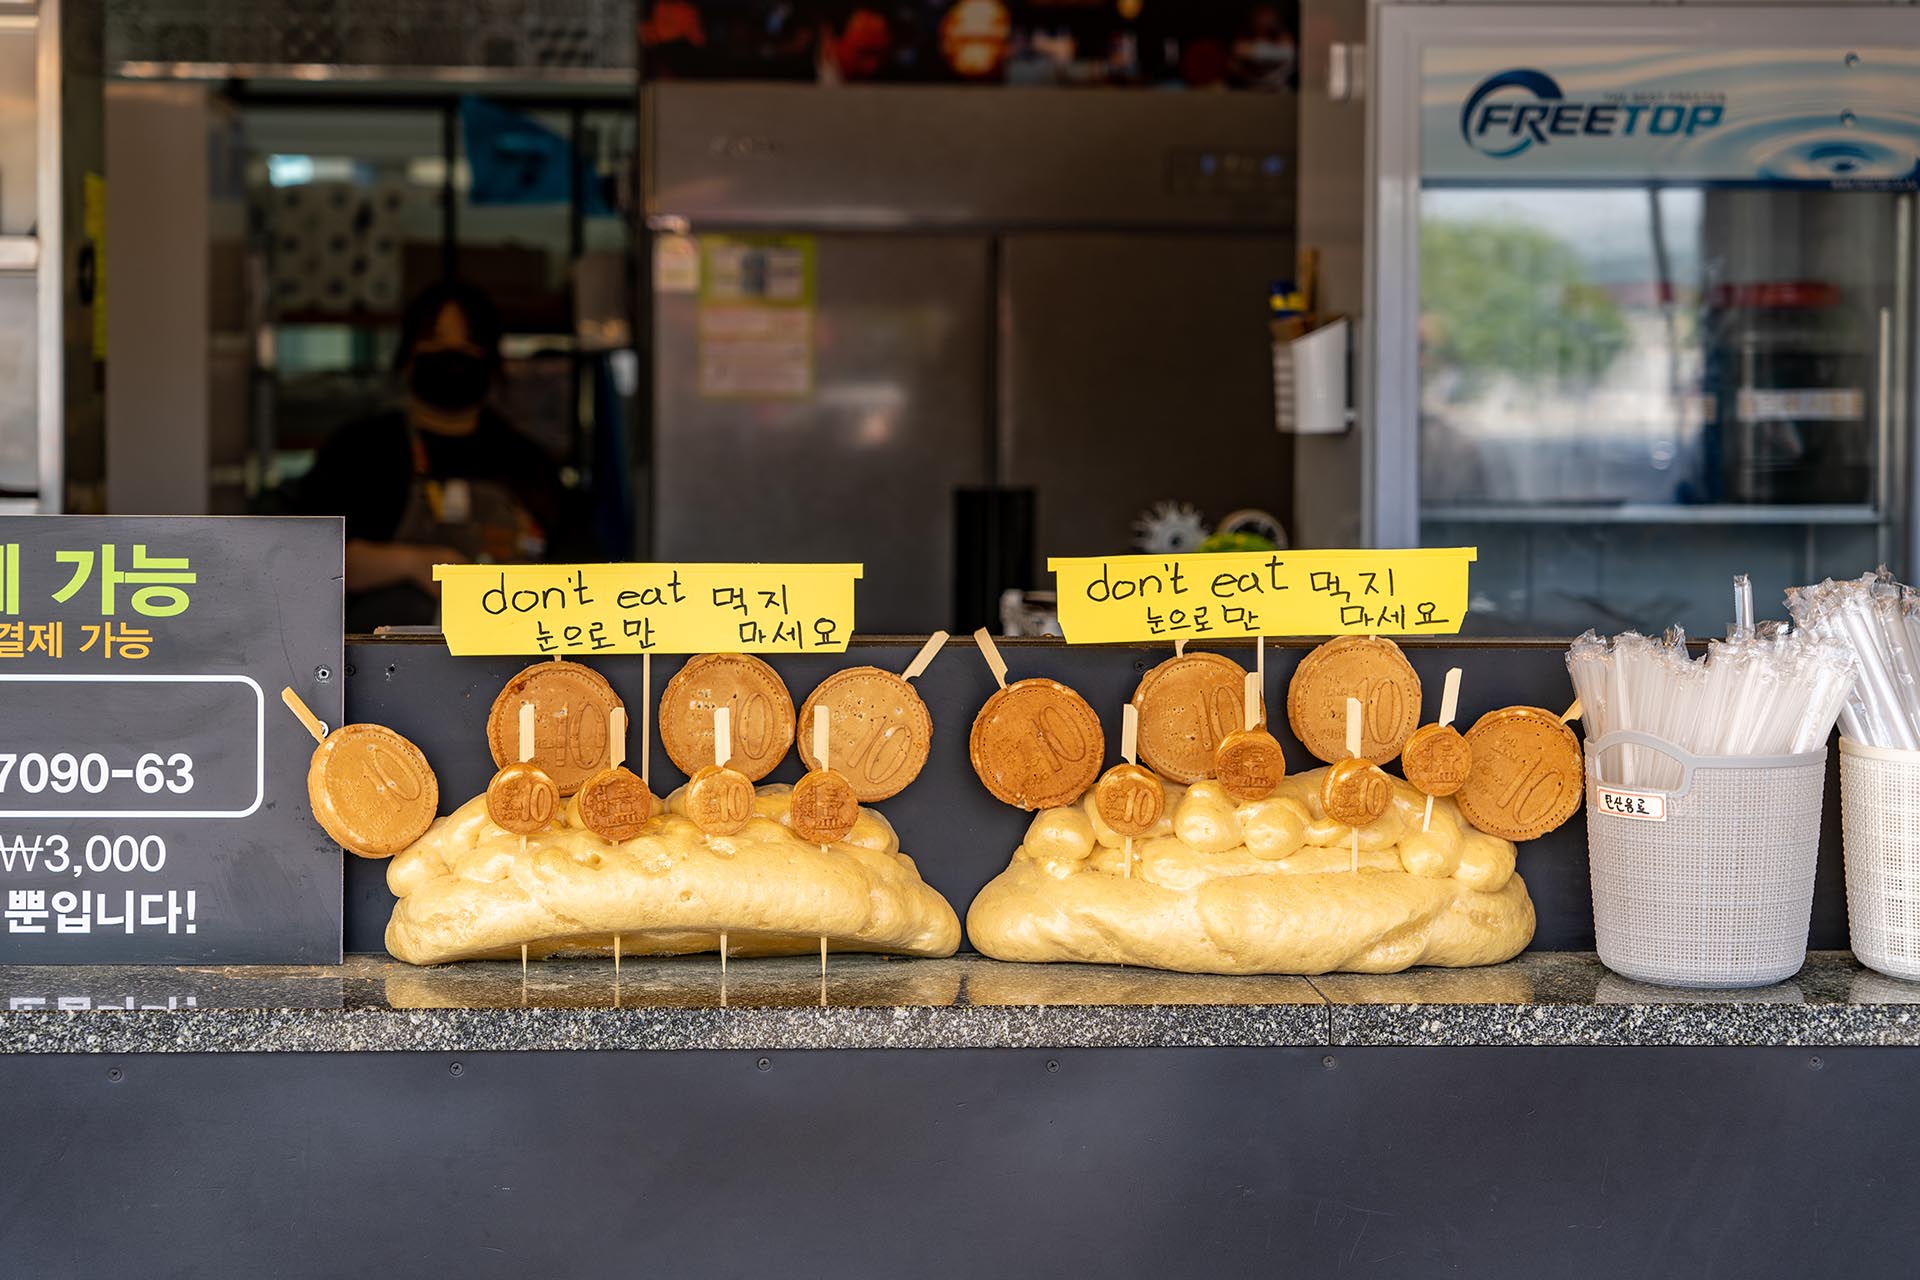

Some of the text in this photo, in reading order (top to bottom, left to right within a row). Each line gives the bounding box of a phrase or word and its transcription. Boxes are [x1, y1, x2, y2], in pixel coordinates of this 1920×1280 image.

[1475, 103, 1725, 145] FREETOP
[51, 543, 197, 617] 가능
[482, 570, 788, 616] don't eat 먹지
[1086, 555, 1394, 602] don't eat 먹지
[739, 616, 842, 645] 마세요
[1340, 602, 1449, 628] 마세요
[0, 621, 153, 660] 결제 가능
[4, 890, 197, 935] 뿐입니다!
